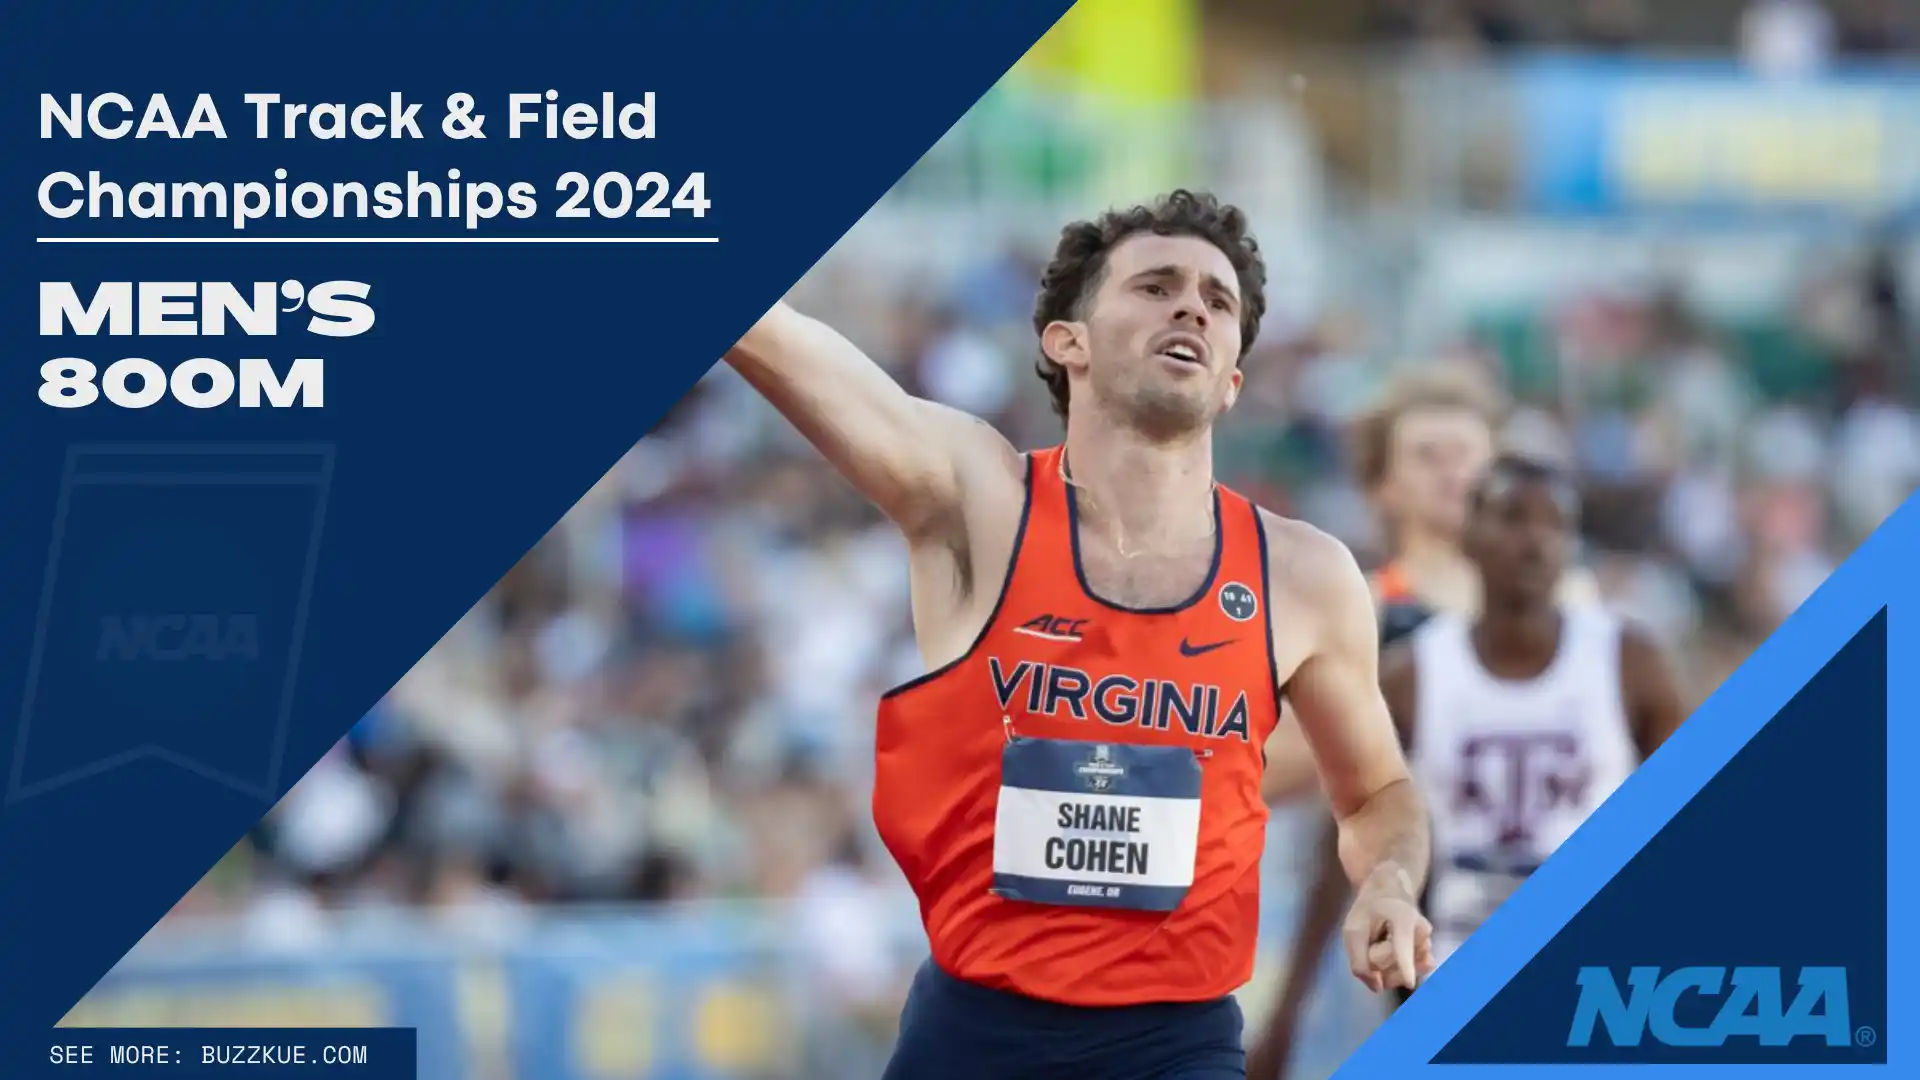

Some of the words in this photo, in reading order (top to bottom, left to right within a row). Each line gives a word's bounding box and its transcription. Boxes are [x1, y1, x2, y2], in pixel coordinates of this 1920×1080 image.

[1021, 613, 1091, 638] ACC
[988, 656, 1249, 743] VIRGINIA
[1057, 802, 1141, 833] SHANE
[1045, 836, 1149, 875] COHEN
